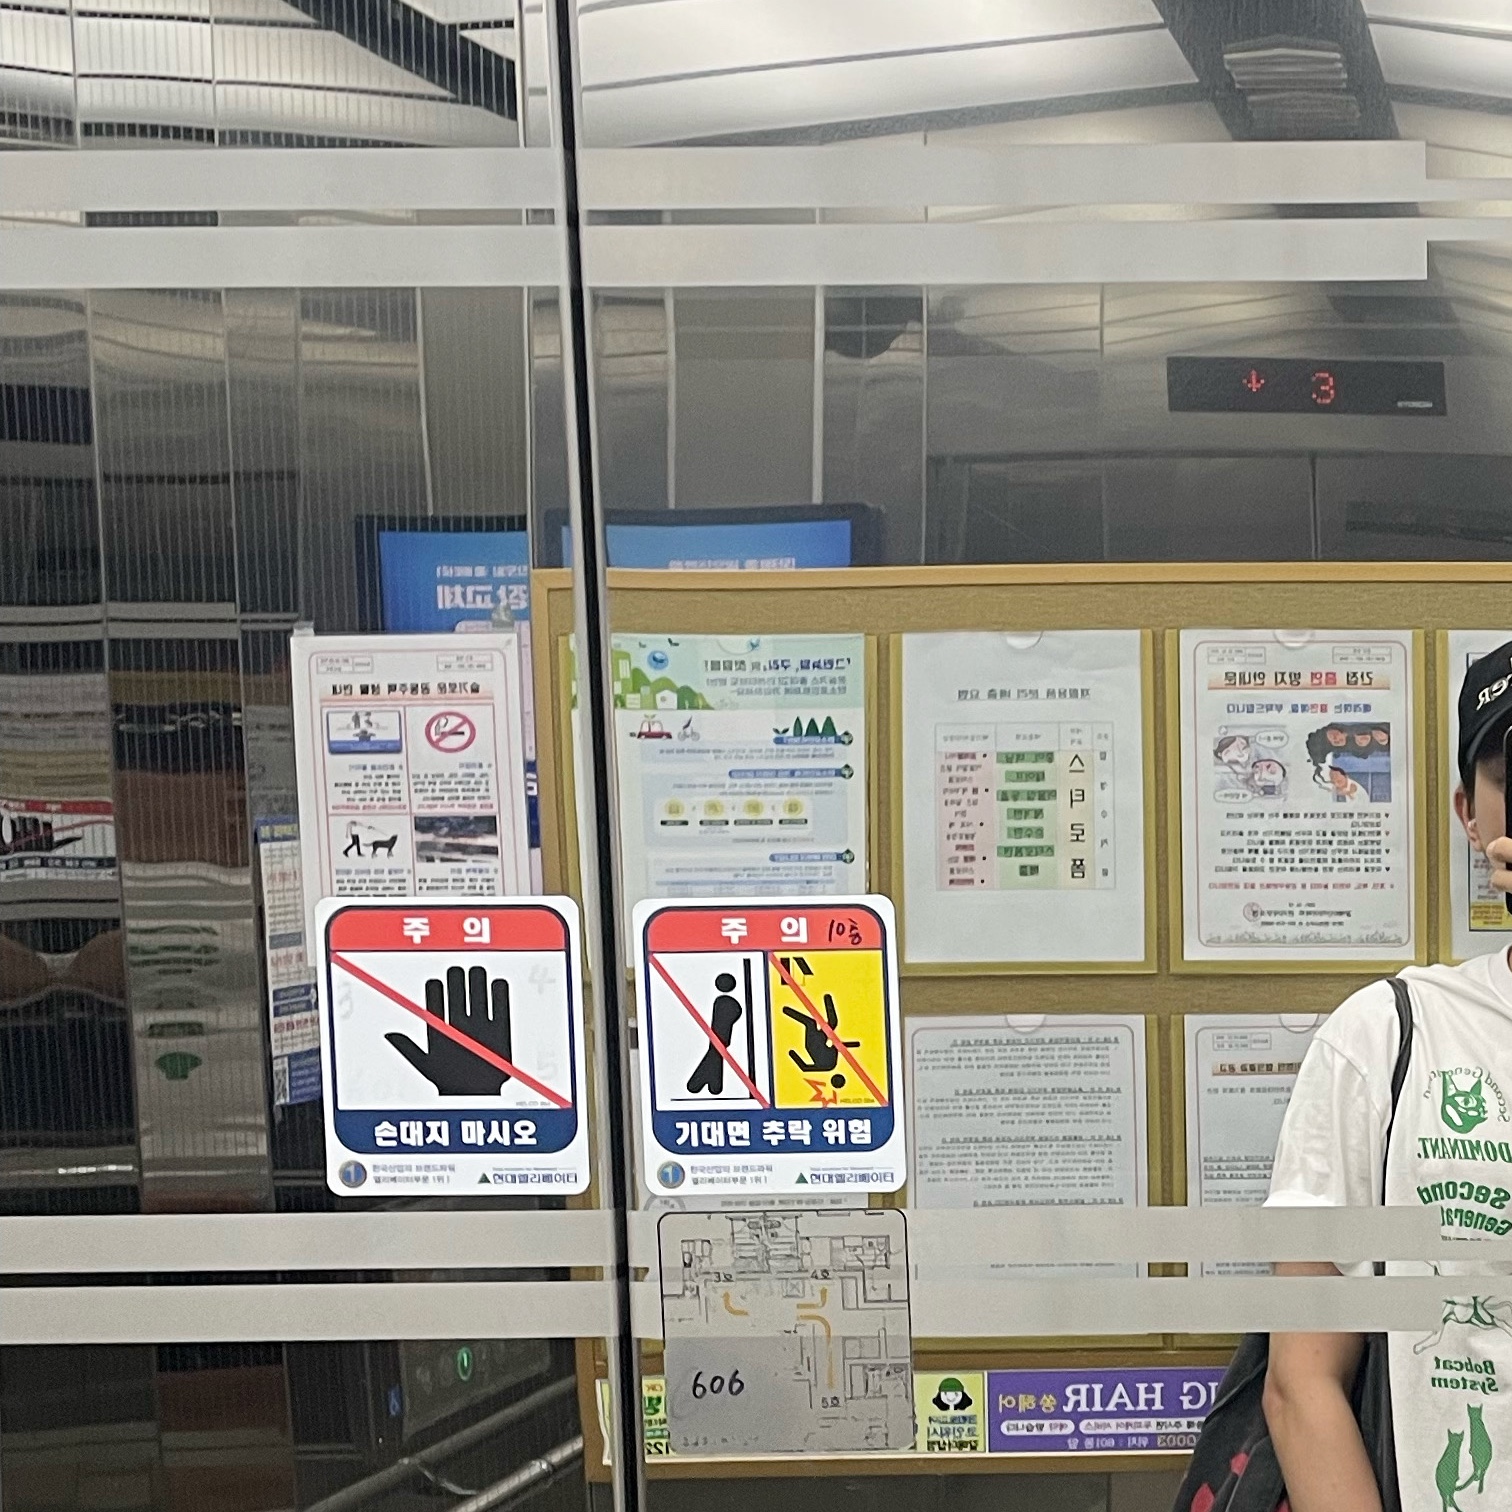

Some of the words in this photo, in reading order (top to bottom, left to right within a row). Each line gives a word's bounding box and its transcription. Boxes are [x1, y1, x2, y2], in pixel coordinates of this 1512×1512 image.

[1312, 372, 1335, 404] 3
[403, 917, 430, 944] 주
[463, 917, 490, 944] 의
[721, 917, 748, 944] 주
[780, 917, 807, 943] 의
[374, 1121, 450, 1147] 손대지
[461, 1119, 537, 1147] 마시오
[675, 1120, 750, 1147] 기대면
[762, 1120, 813, 1146] 추락
[823, 1118, 871, 1145] 위험
[493, 1173, 577, 1185] 현대엘리베이터
[810, 1172, 894, 1185] 현대엘리베이터
[692, 1369, 745, 1399] 606
